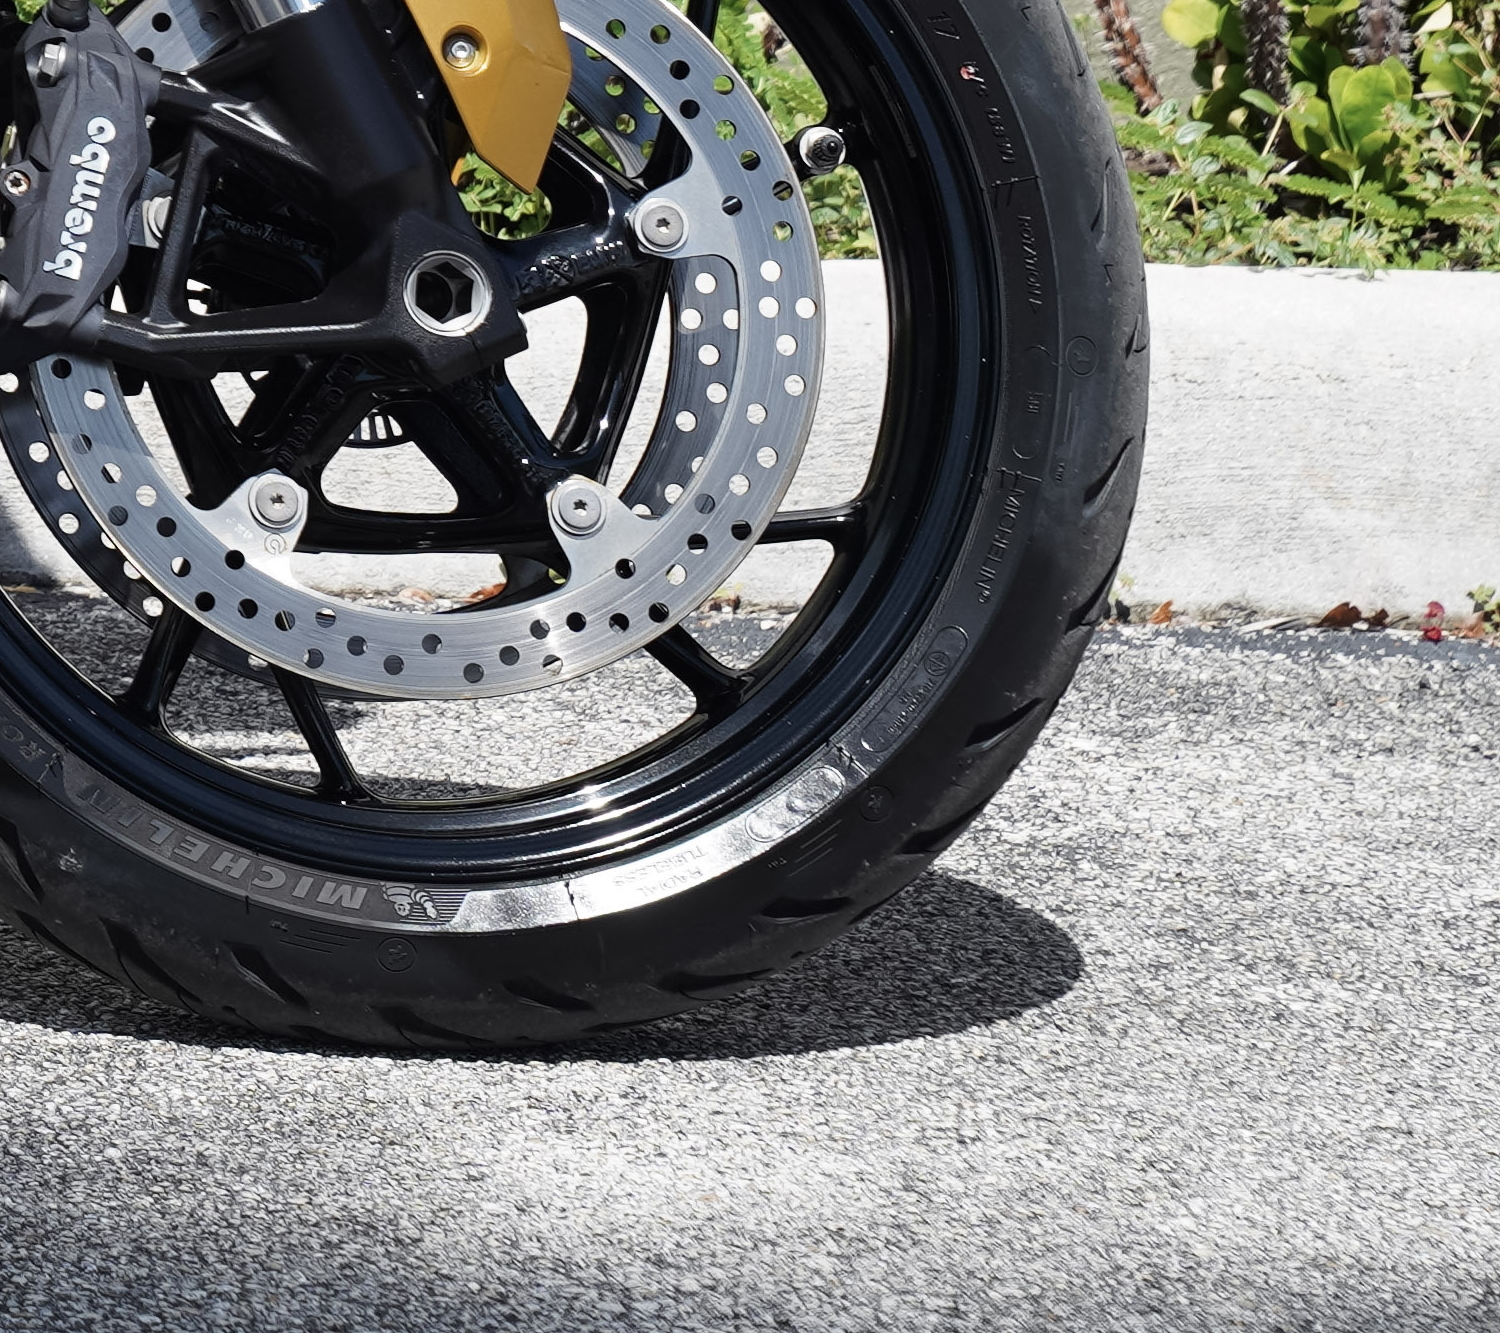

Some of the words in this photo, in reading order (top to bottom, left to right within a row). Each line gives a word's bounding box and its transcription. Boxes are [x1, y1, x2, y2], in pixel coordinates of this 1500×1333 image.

[924, 4, 962, 49] 17
[43, 115, 116, 281] brembo
[73, 775, 367, 910] MICHELIN
[633, 862, 705, 902] RADIAL
